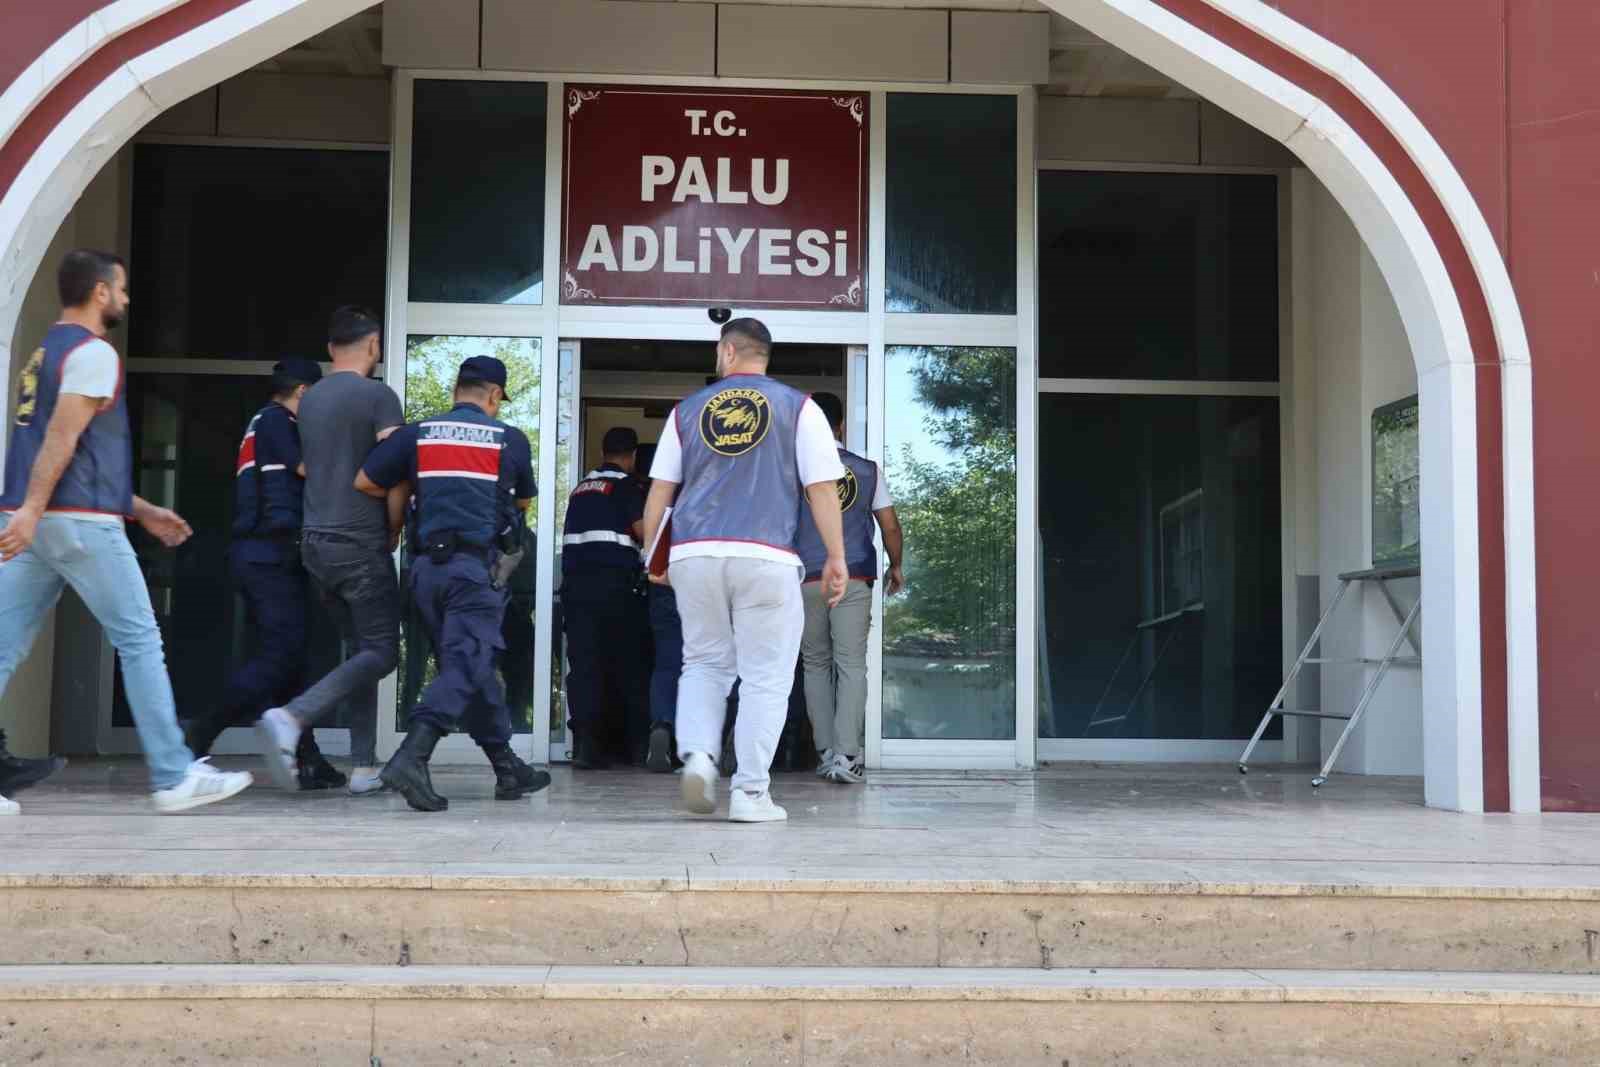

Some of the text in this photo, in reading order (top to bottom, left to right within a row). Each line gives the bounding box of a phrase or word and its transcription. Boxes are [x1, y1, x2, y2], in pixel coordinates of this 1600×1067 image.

[684, 110, 747, 137] T.C.
[641, 155, 790, 206] PALU
[707, 389, 765, 413] JANDARMA
[424, 424, 495, 443] JANDARMA
[714, 431, 754, 447] JASAT
